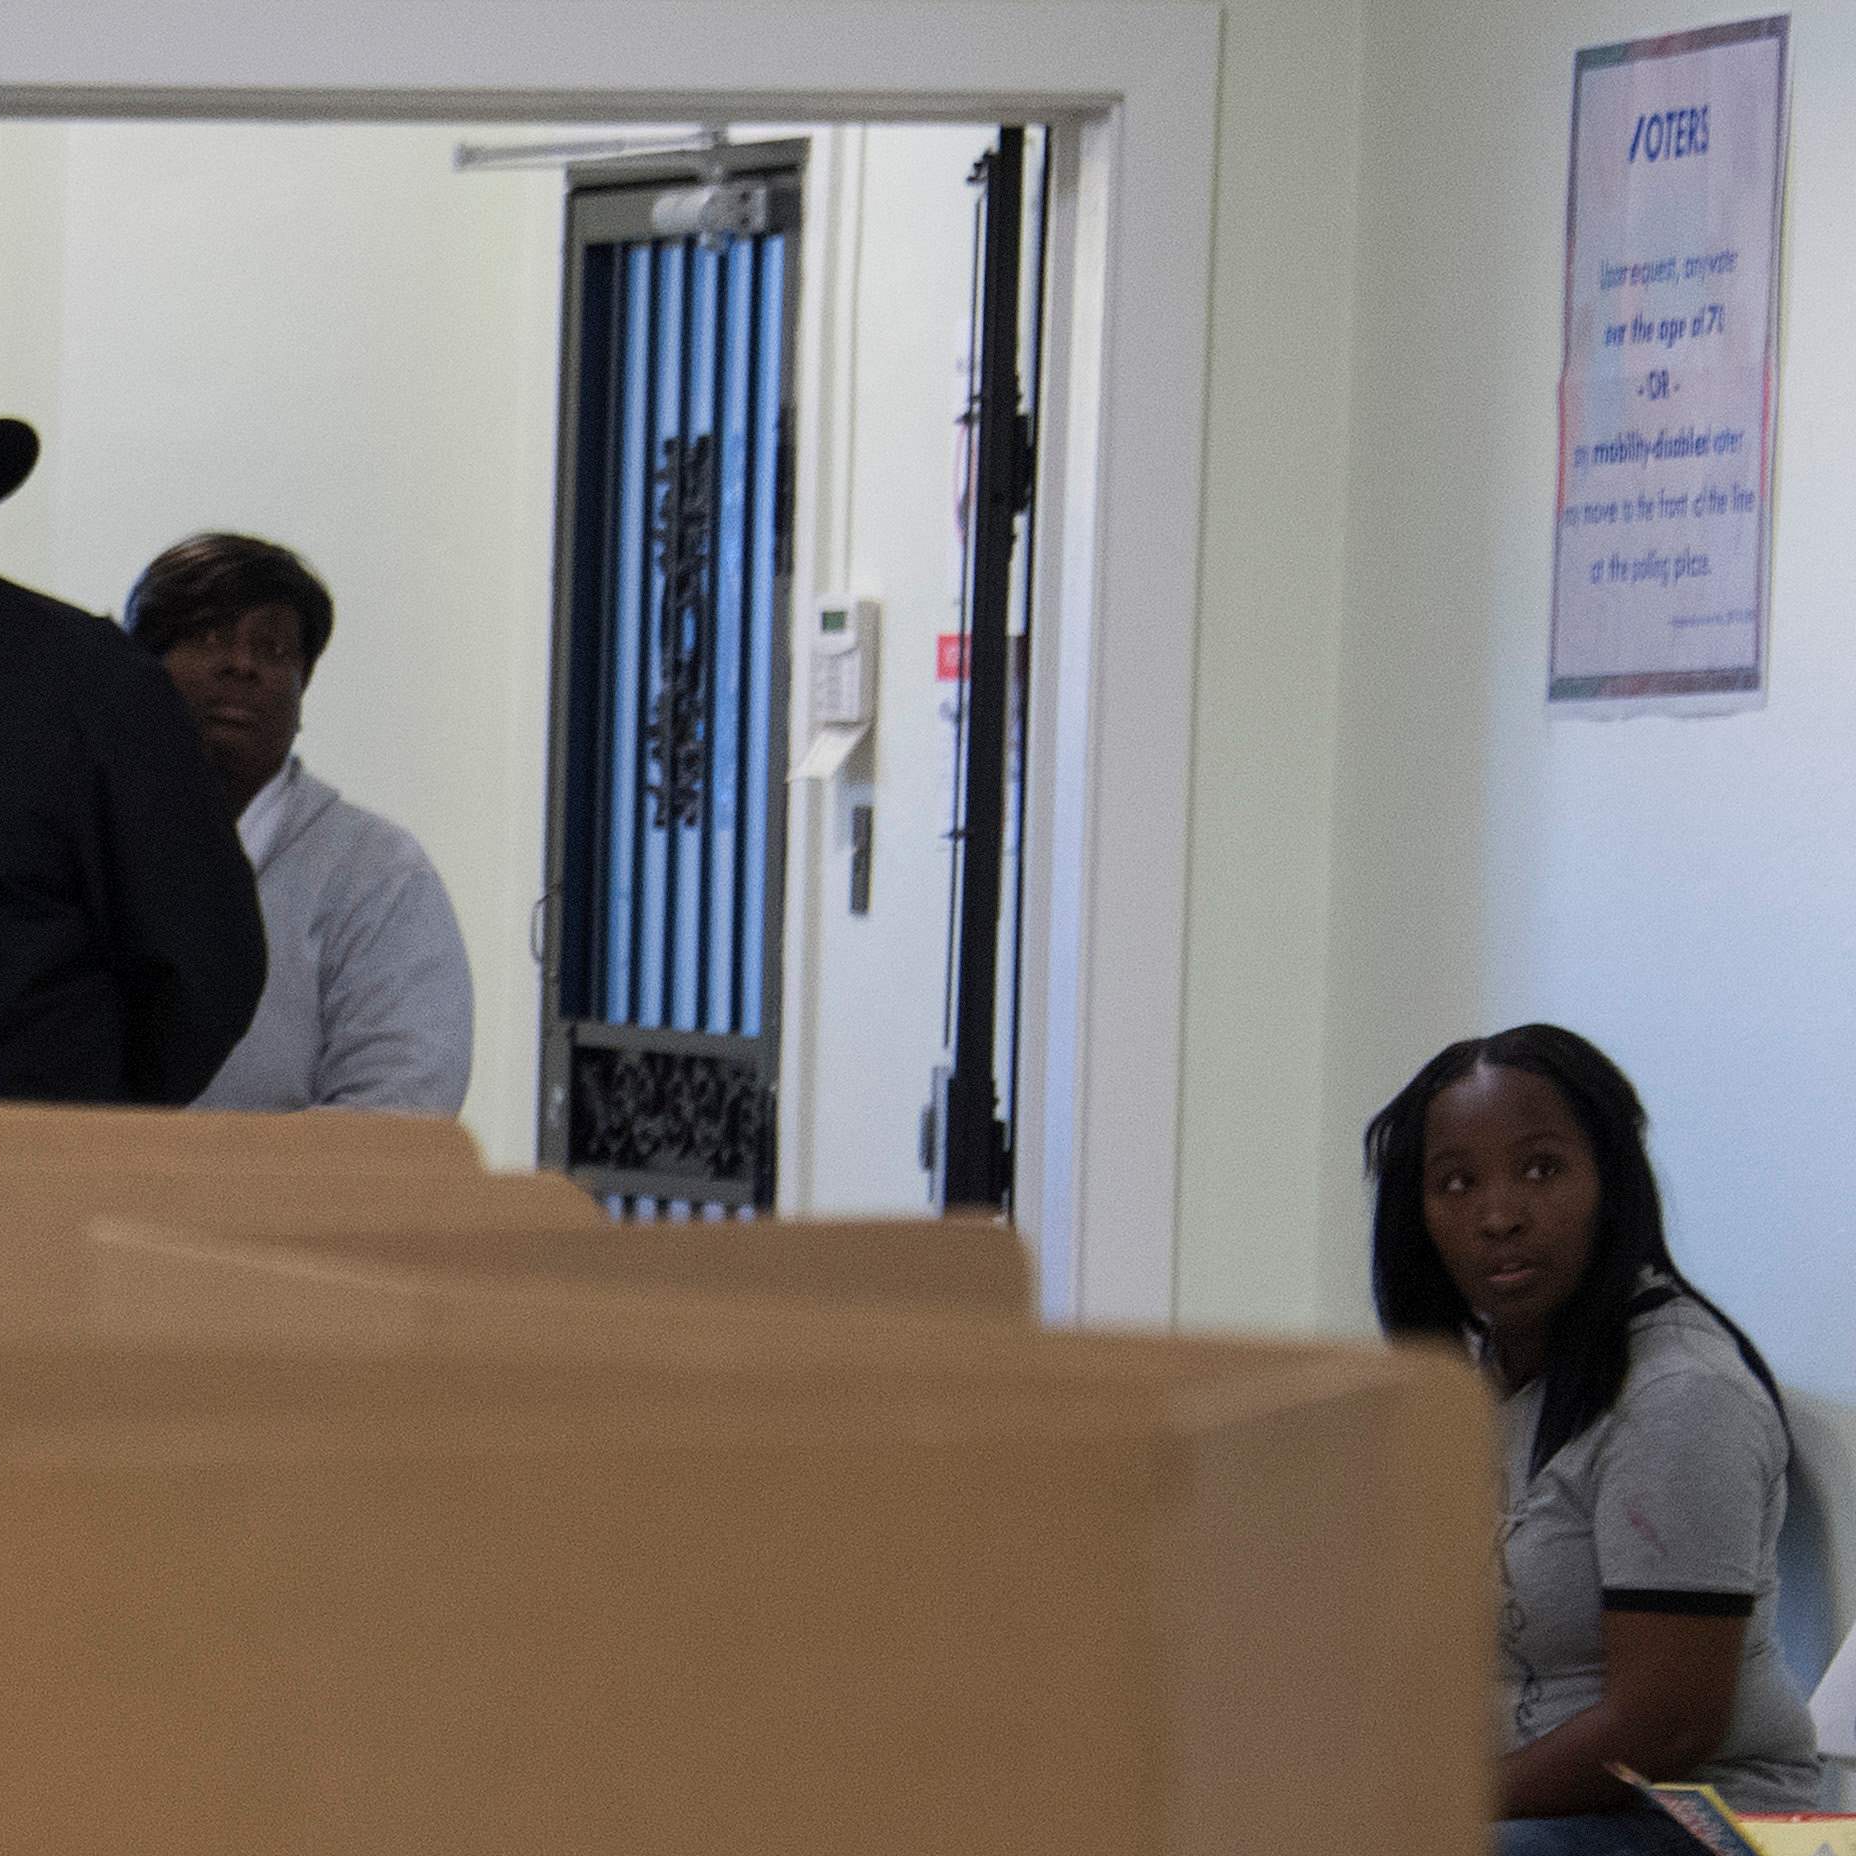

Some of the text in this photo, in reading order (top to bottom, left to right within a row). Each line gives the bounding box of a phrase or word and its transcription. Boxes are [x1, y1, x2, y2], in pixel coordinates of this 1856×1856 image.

[1631, 311, 1654, 344] the
[1658, 317, 1687, 349] age
[1583, 501, 1617, 525] move
